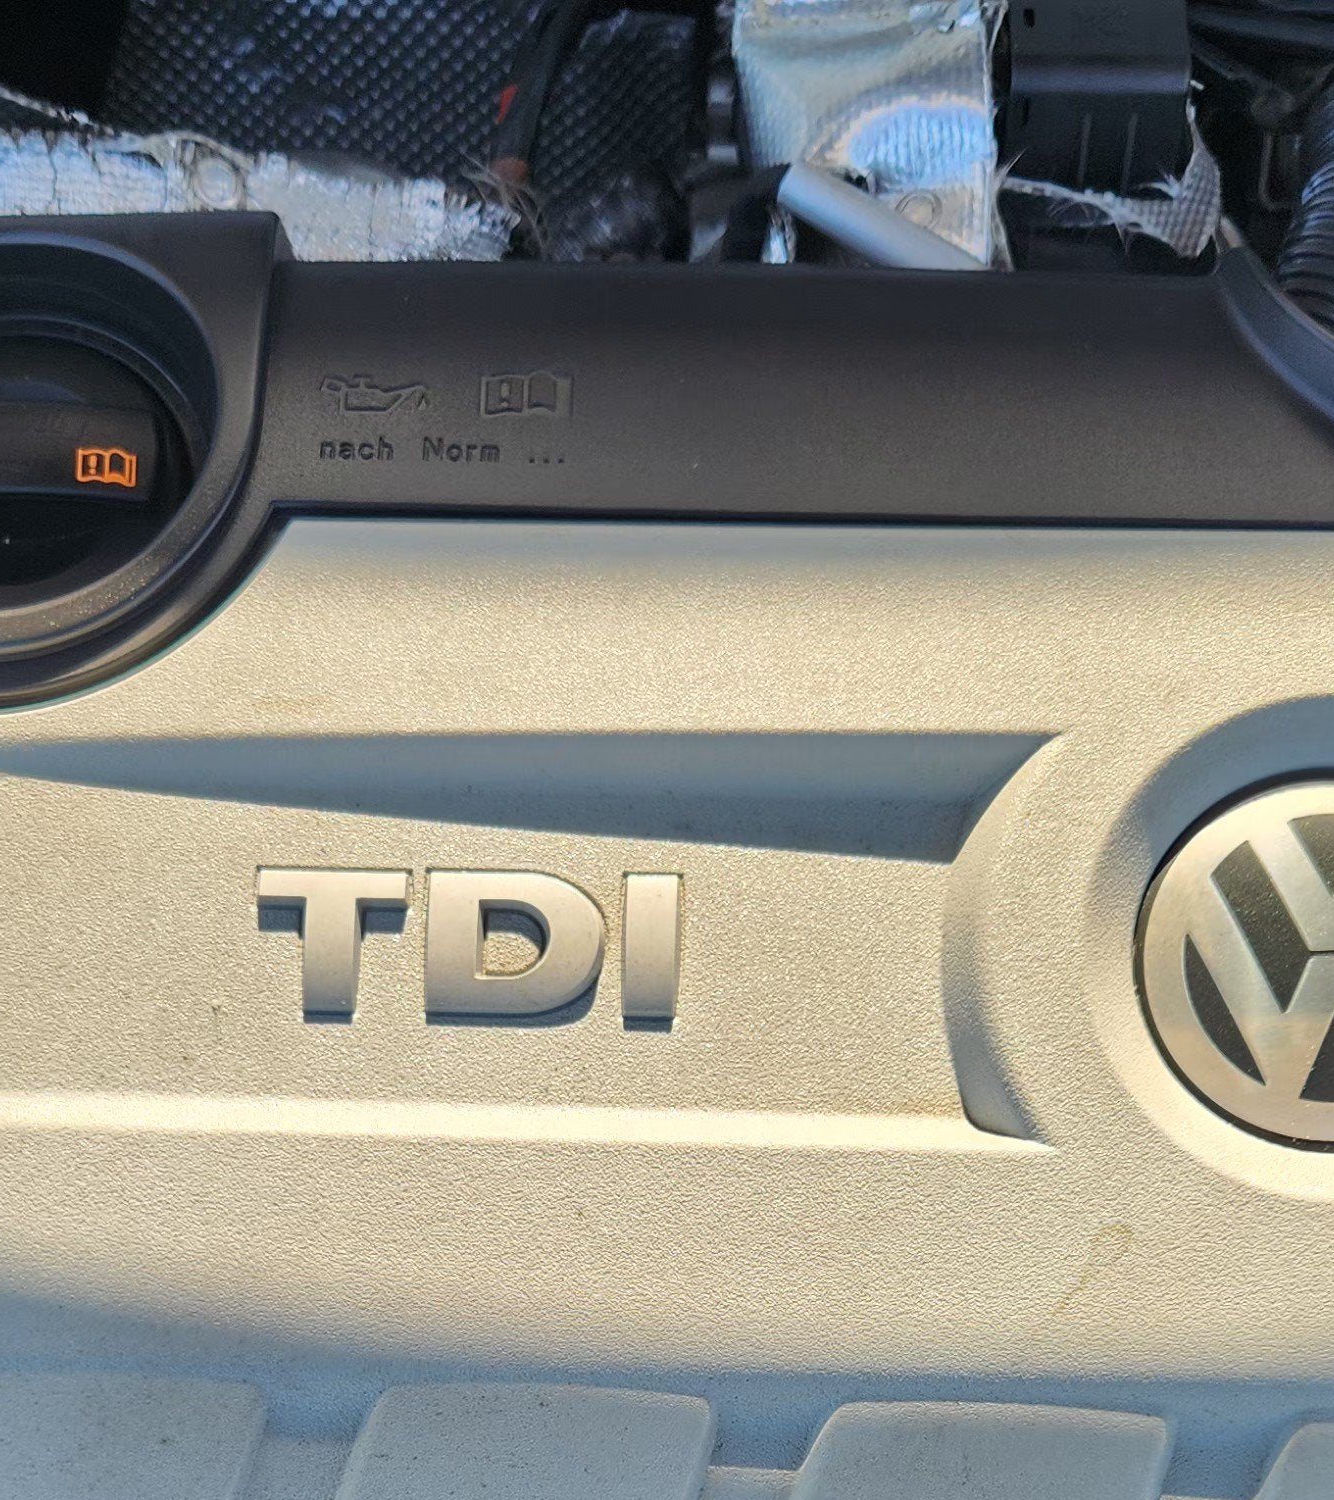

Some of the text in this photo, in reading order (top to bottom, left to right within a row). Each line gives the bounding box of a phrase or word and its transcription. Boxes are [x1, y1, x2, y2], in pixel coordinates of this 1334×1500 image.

[319, 435, 395, 462] nach
[422, 435, 502, 464] Norm
[256, 866, 684, 1030] TDI
